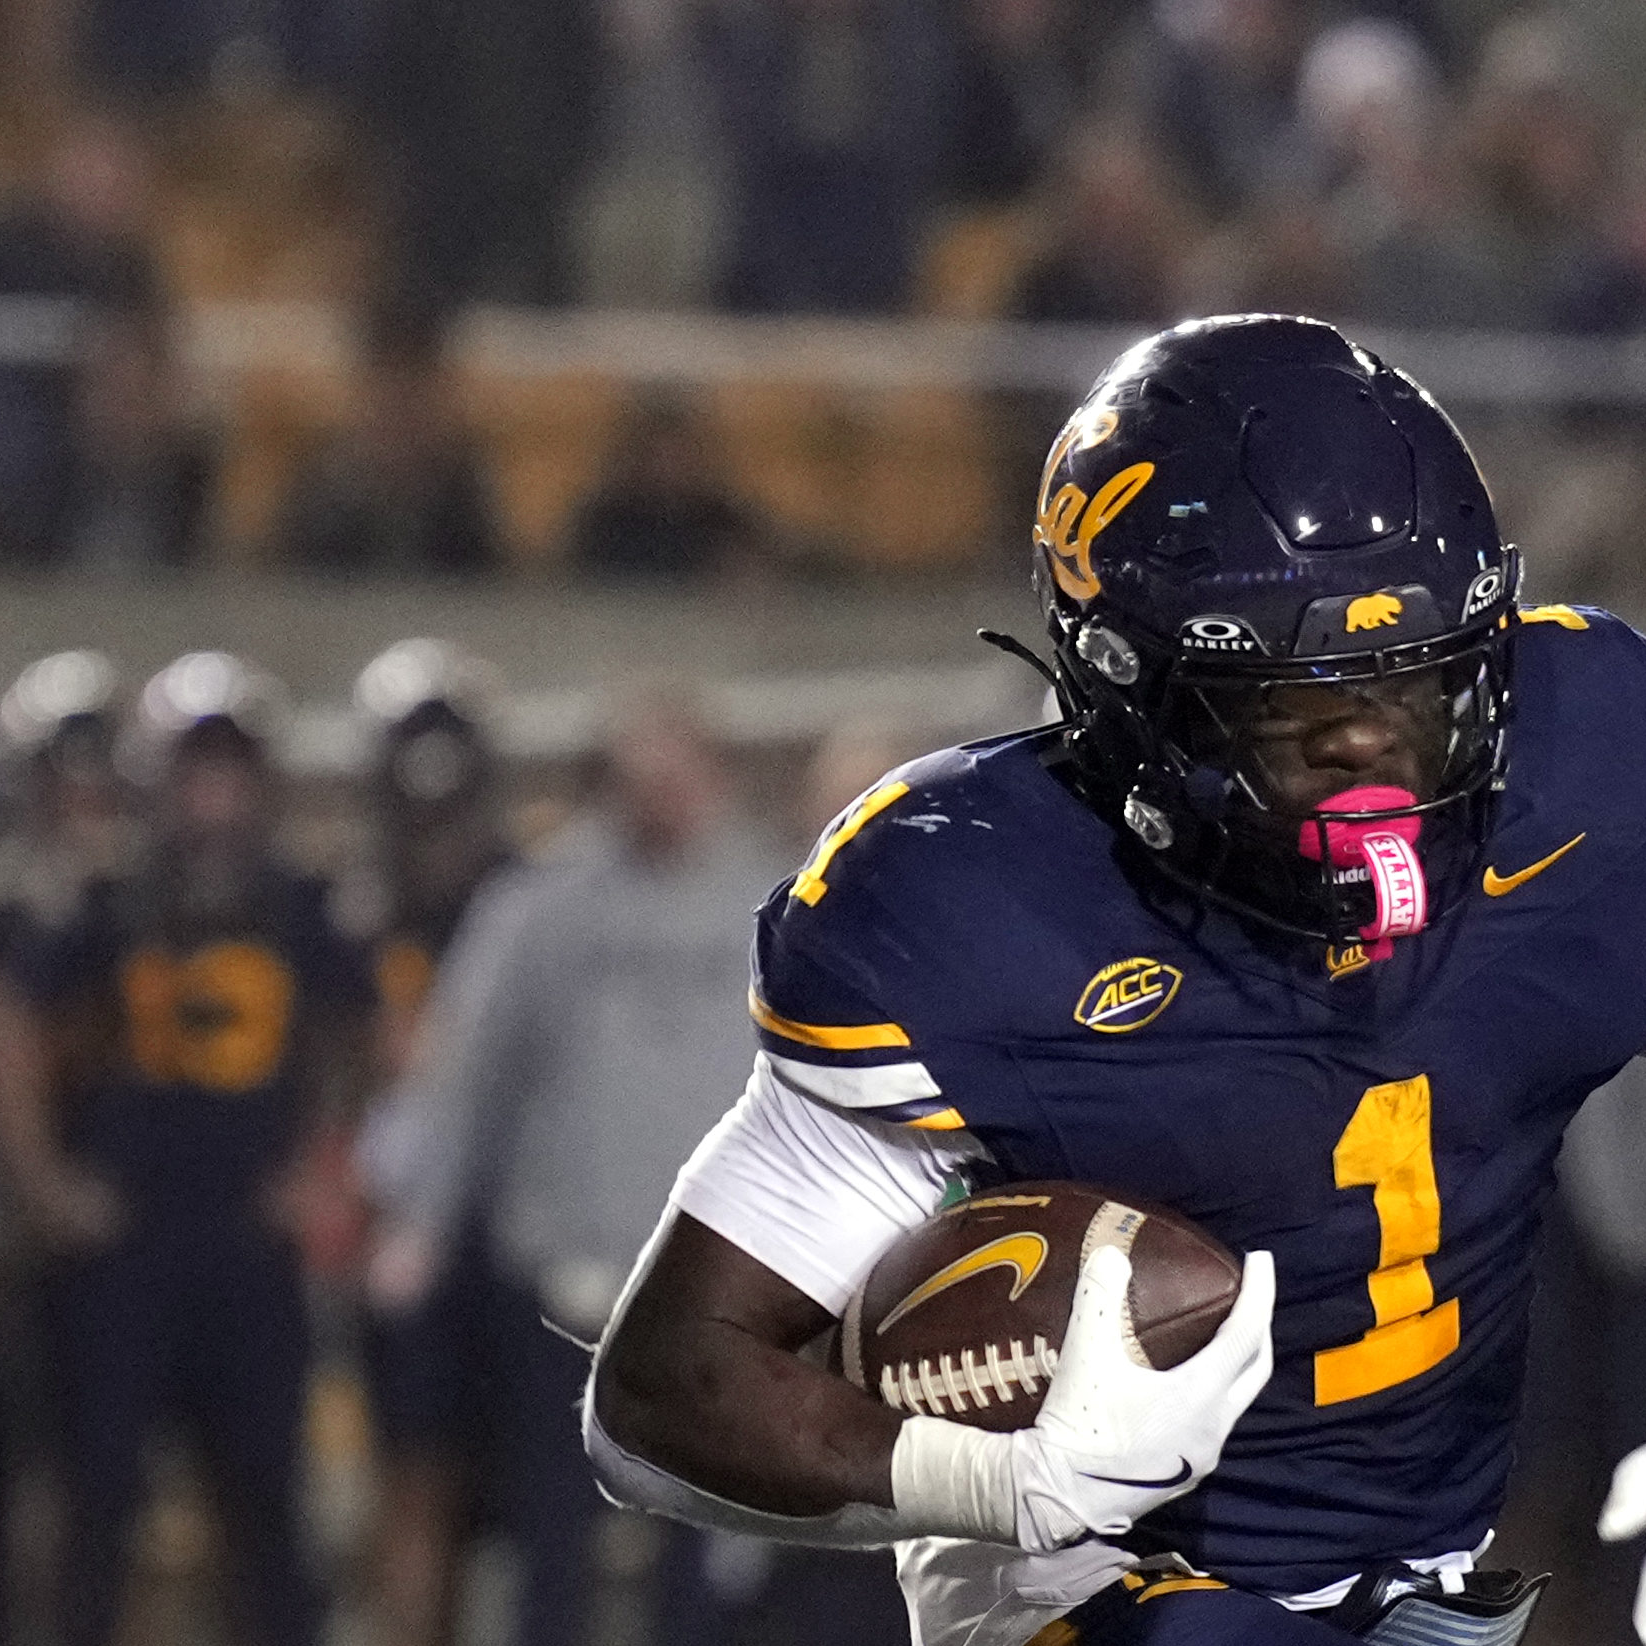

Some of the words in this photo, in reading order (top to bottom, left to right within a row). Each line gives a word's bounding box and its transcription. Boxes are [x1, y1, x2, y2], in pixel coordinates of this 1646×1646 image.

[1469, 587, 1502, 615] OAKLEY
[1182, 637, 1255, 651] OAKLEY
[1090, 964, 1164, 1017] ACC
[1314, 1072, 1460, 1408] 1
